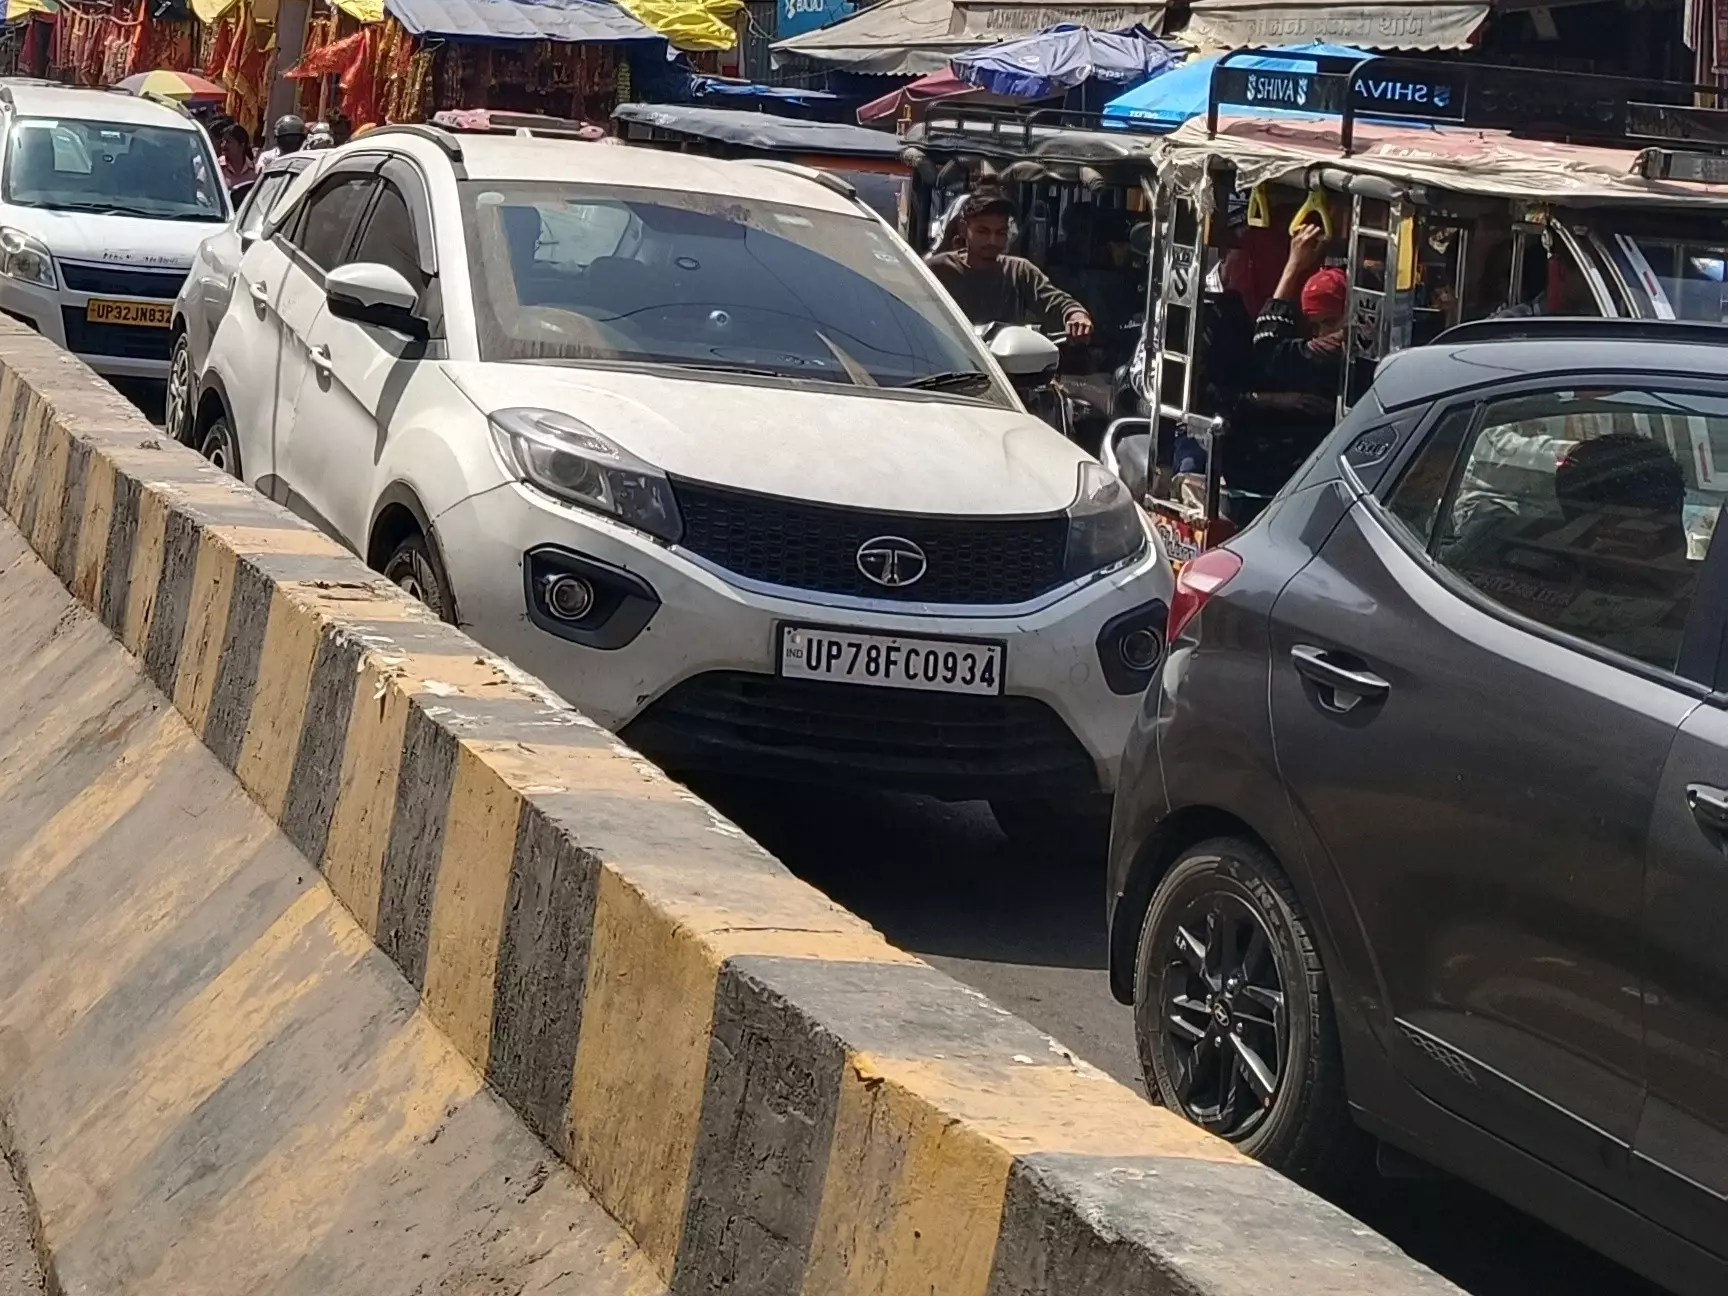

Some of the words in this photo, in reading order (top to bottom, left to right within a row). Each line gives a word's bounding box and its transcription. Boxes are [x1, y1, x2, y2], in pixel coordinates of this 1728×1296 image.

[1256, 79, 1295, 101] SHIVA
[786, 647, 804, 660] IND
[805, 636, 998, 688] UP78FC0934
